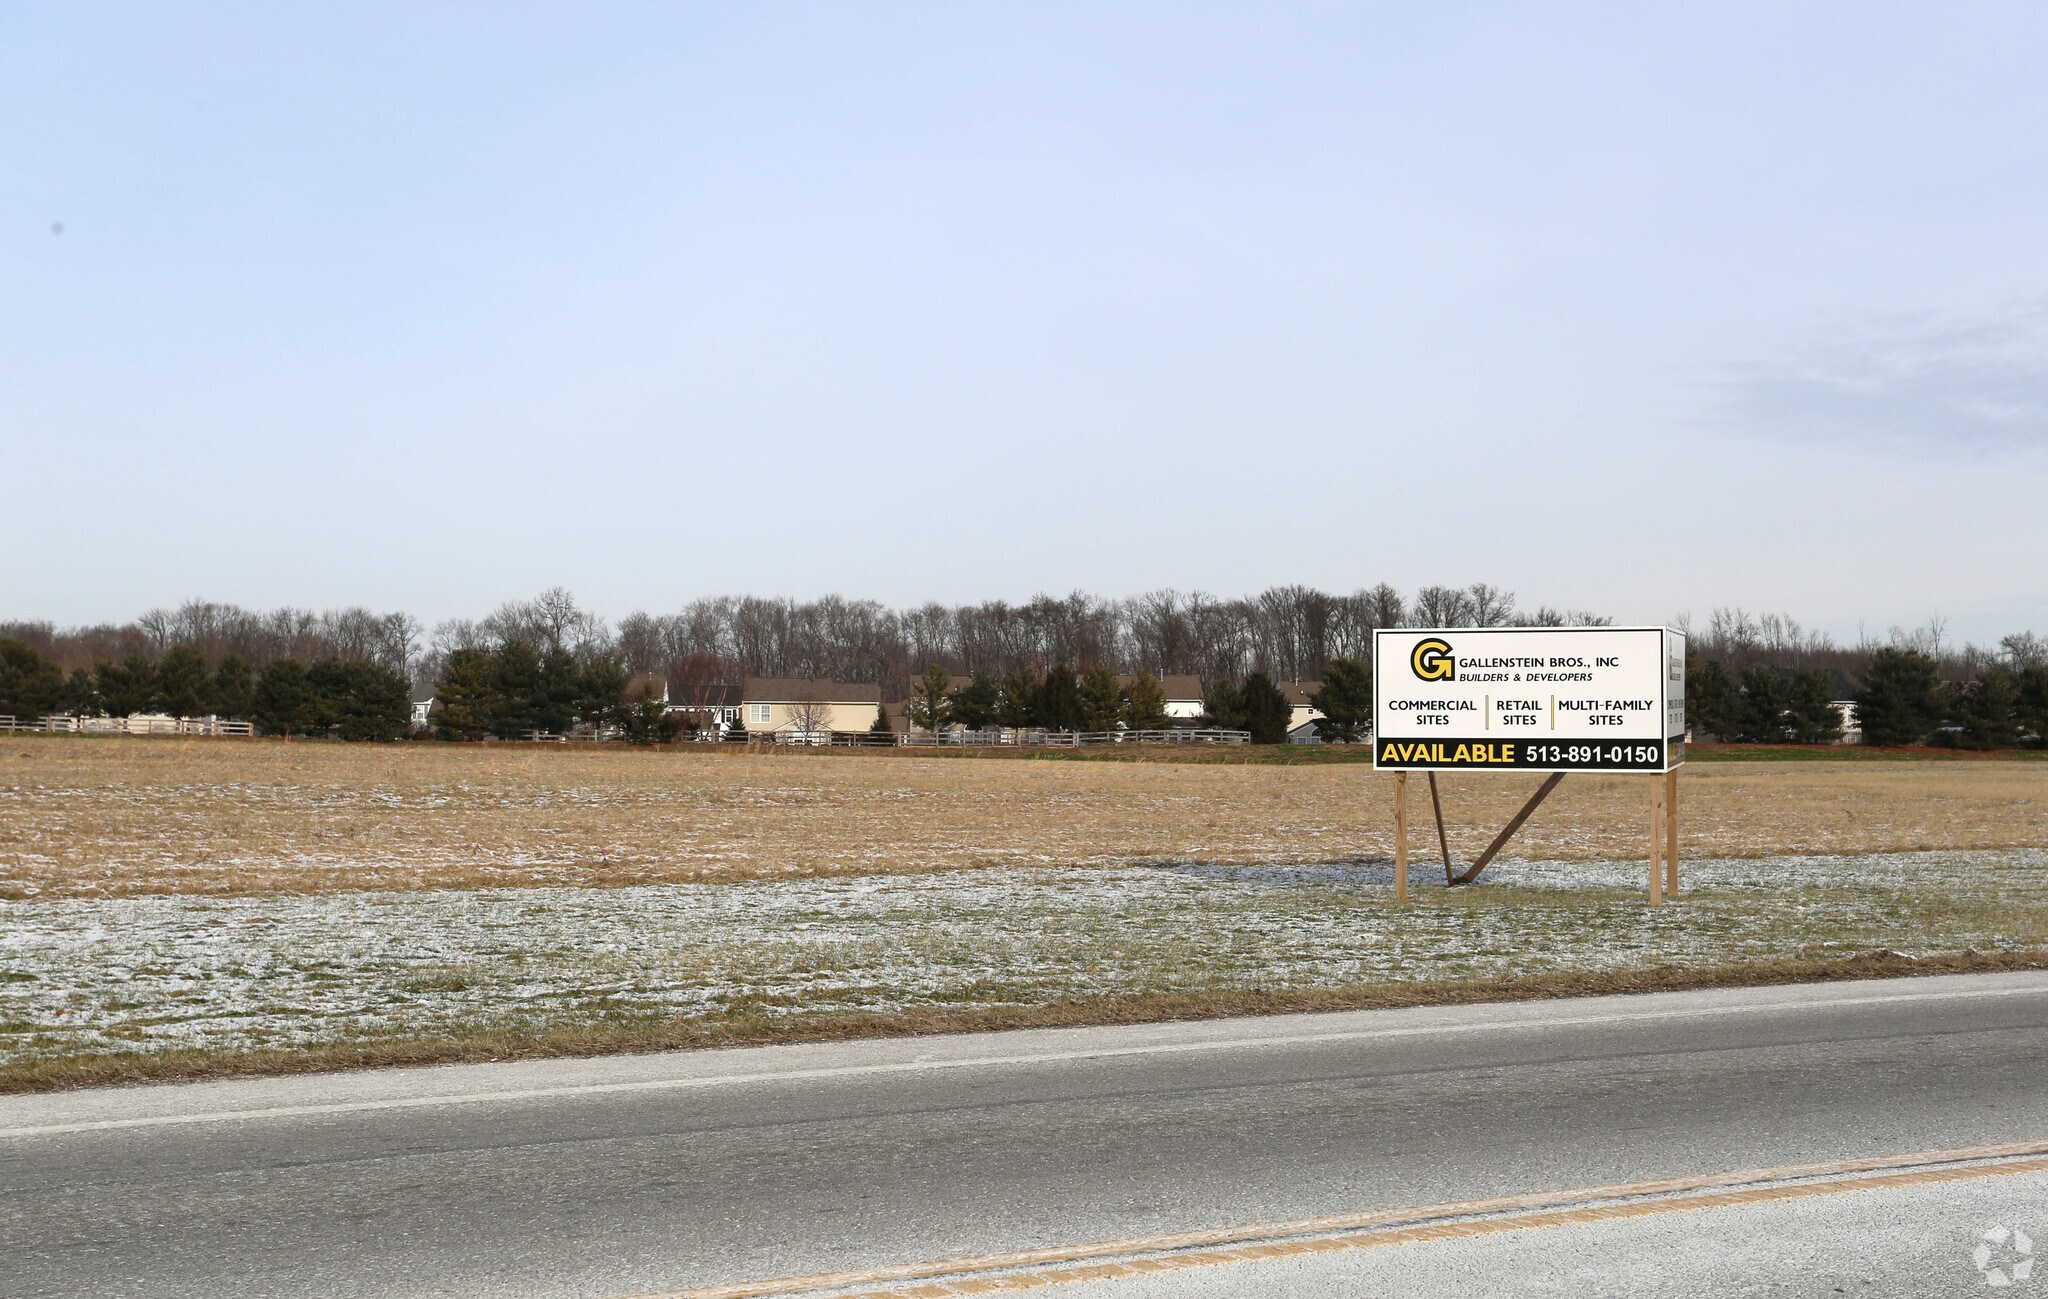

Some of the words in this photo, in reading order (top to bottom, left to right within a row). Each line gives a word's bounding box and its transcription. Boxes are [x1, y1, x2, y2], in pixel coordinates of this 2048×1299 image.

[1460, 658, 1544, 667] GALLENSTEIN
[1550, 658, 1590, 668] BROS.,
[1596, 657, 1618, 666] INC
[1526, 673, 1592, 681] DEVELOPERS
[1389, 701, 1477, 710] COMMERCIAL
[1497, 701, 1542, 710] RETAIL
[1559, 701, 1653, 710] MULTI-FAMILY
[1417, 715, 1449, 725] SITES
[1504, 715, 1536, 725] SITES
[1589, 715, 1623, 725] SITES
[1381, 744, 1514, 762] AVAILABLE
[1527, 746, 1658, 762] 513-891-0150
